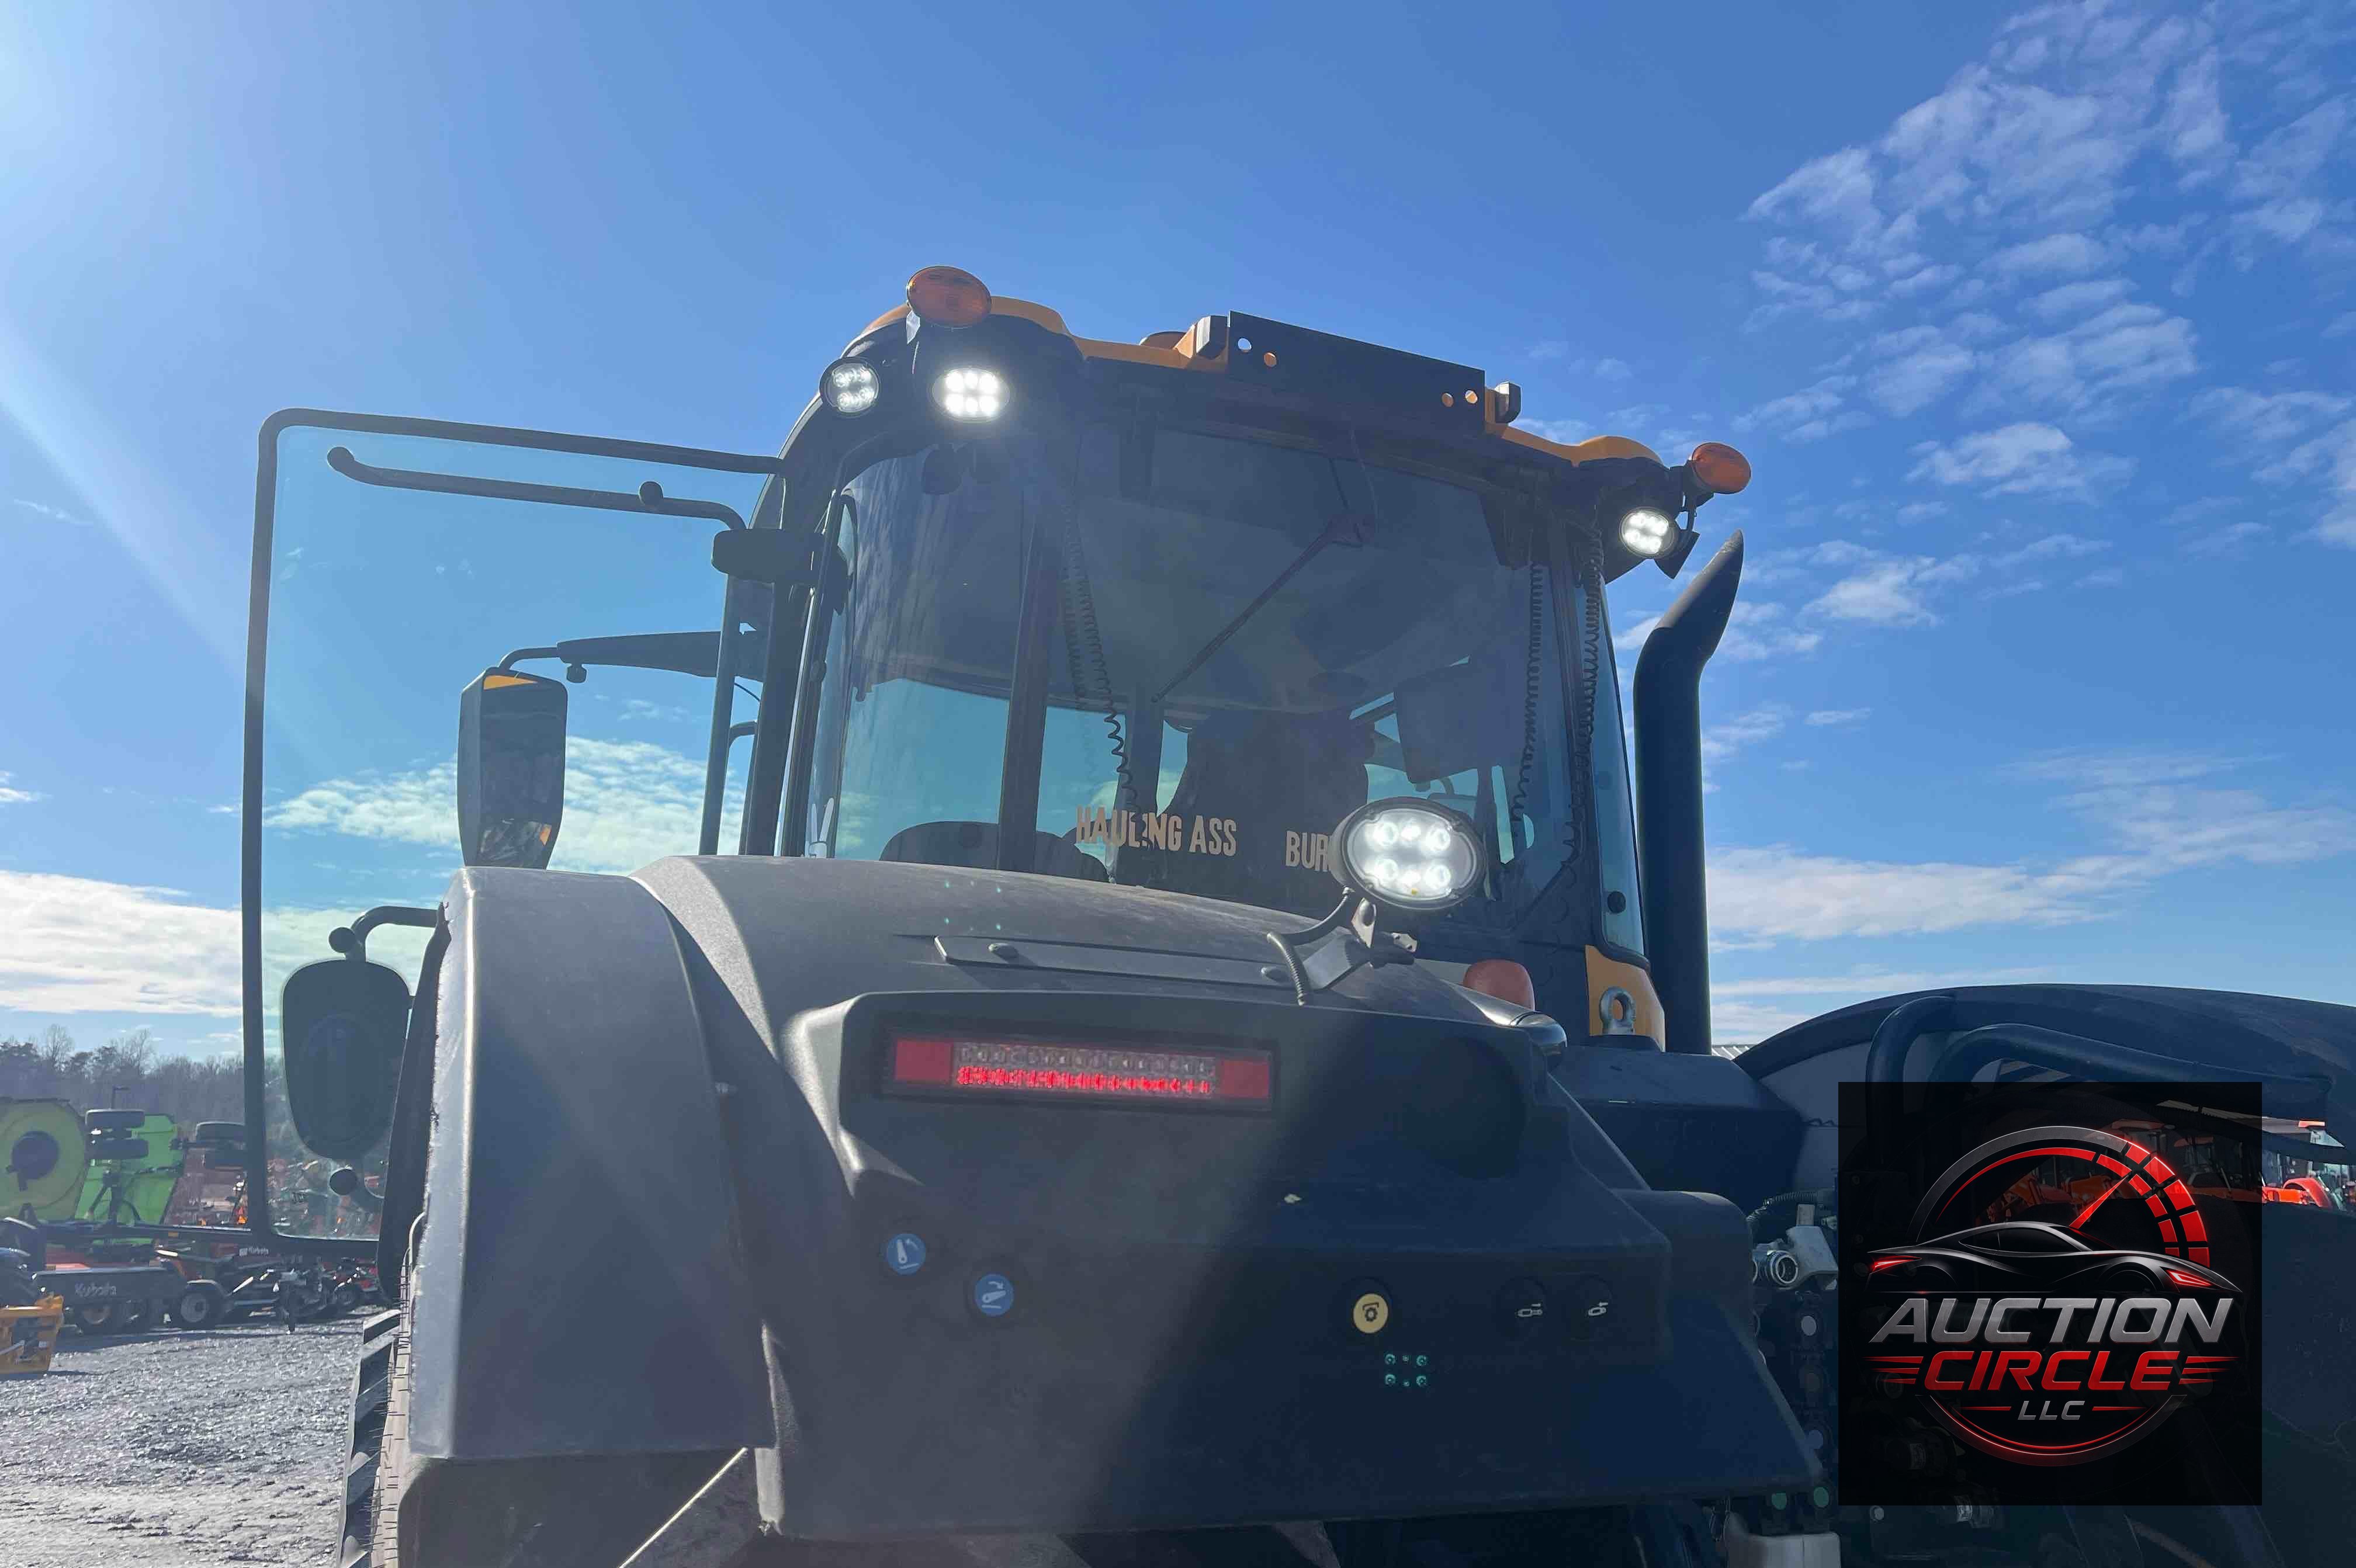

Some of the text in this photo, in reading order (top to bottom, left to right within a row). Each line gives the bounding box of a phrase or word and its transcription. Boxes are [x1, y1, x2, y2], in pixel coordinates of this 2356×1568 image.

[1076, 804, 1333, 872] HAULING ASS BUR
[75, 1282, 117, 1298] Kubota
